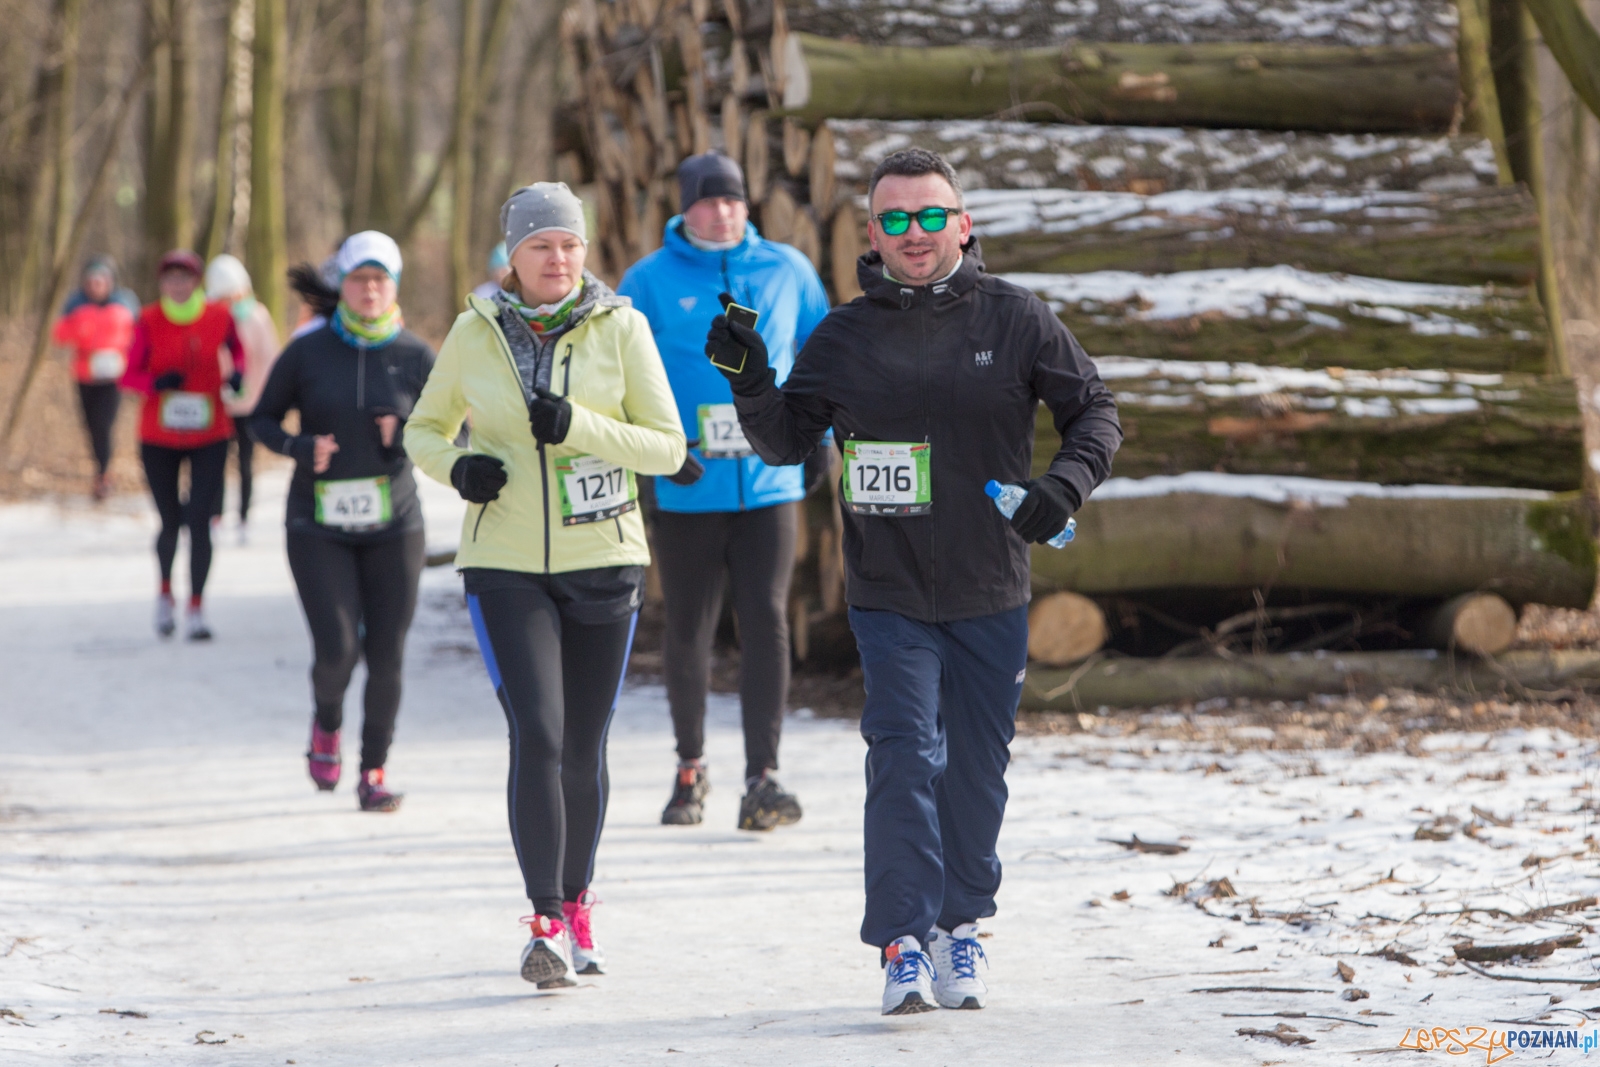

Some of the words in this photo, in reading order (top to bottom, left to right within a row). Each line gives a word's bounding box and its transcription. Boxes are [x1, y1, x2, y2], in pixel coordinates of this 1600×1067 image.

[975, 350, 993, 361] A&F
[576, 467, 623, 502] 1217
[857, 464, 911, 492] 1216
[334, 494, 373, 515] 412
